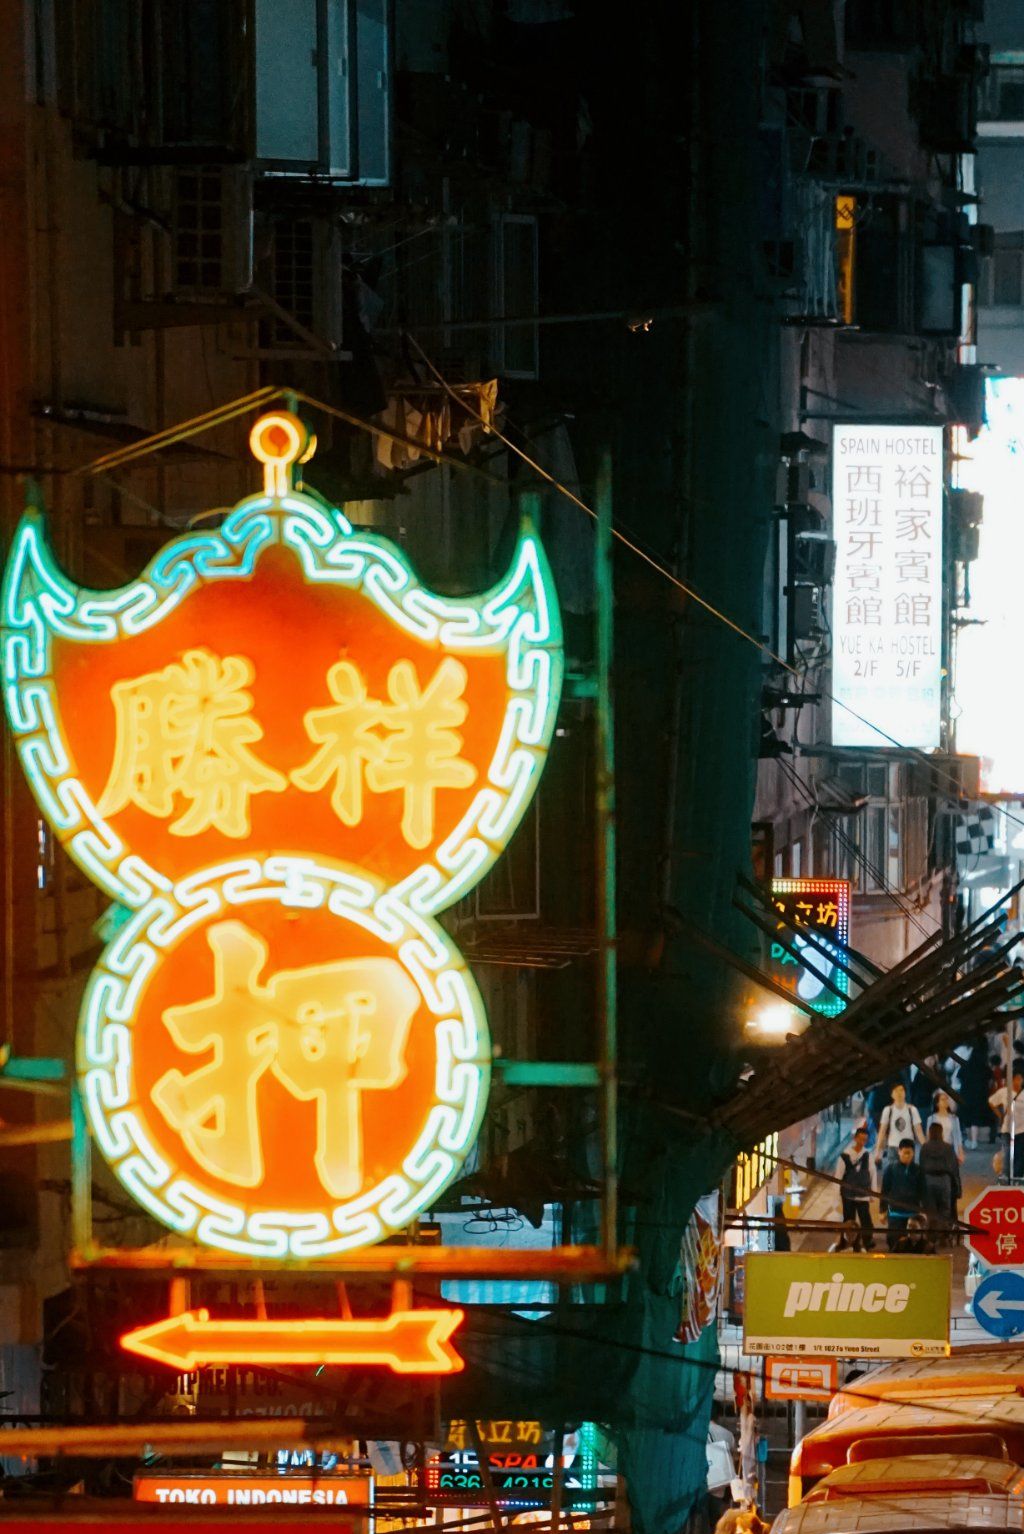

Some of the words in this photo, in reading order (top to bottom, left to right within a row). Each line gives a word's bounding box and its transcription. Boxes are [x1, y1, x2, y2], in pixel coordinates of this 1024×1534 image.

[840, 438, 879, 455] SPAIN
[885, 438, 937, 455] HOSTEL
[845, 465, 883, 626] 西班牙賓館
[894, 464, 932, 627] 裕家賓館
[839, 635, 862, 655] YUE
[869, 636, 884, 655] KA
[891, 635, 936, 655] HOSTEL
[853, 659, 879, 678] 2/F
[895, 659, 922, 678] 5/F
[151, 919, 423, 1199] 押
[995, 1233, 1018, 1256] 停
[783, 1272, 910, 1318] prince
[489, 1452, 539, 1468] SPA
[155, 1488, 217, 1504] TOKO
[227, 1488, 348, 1504] INDONESIA
